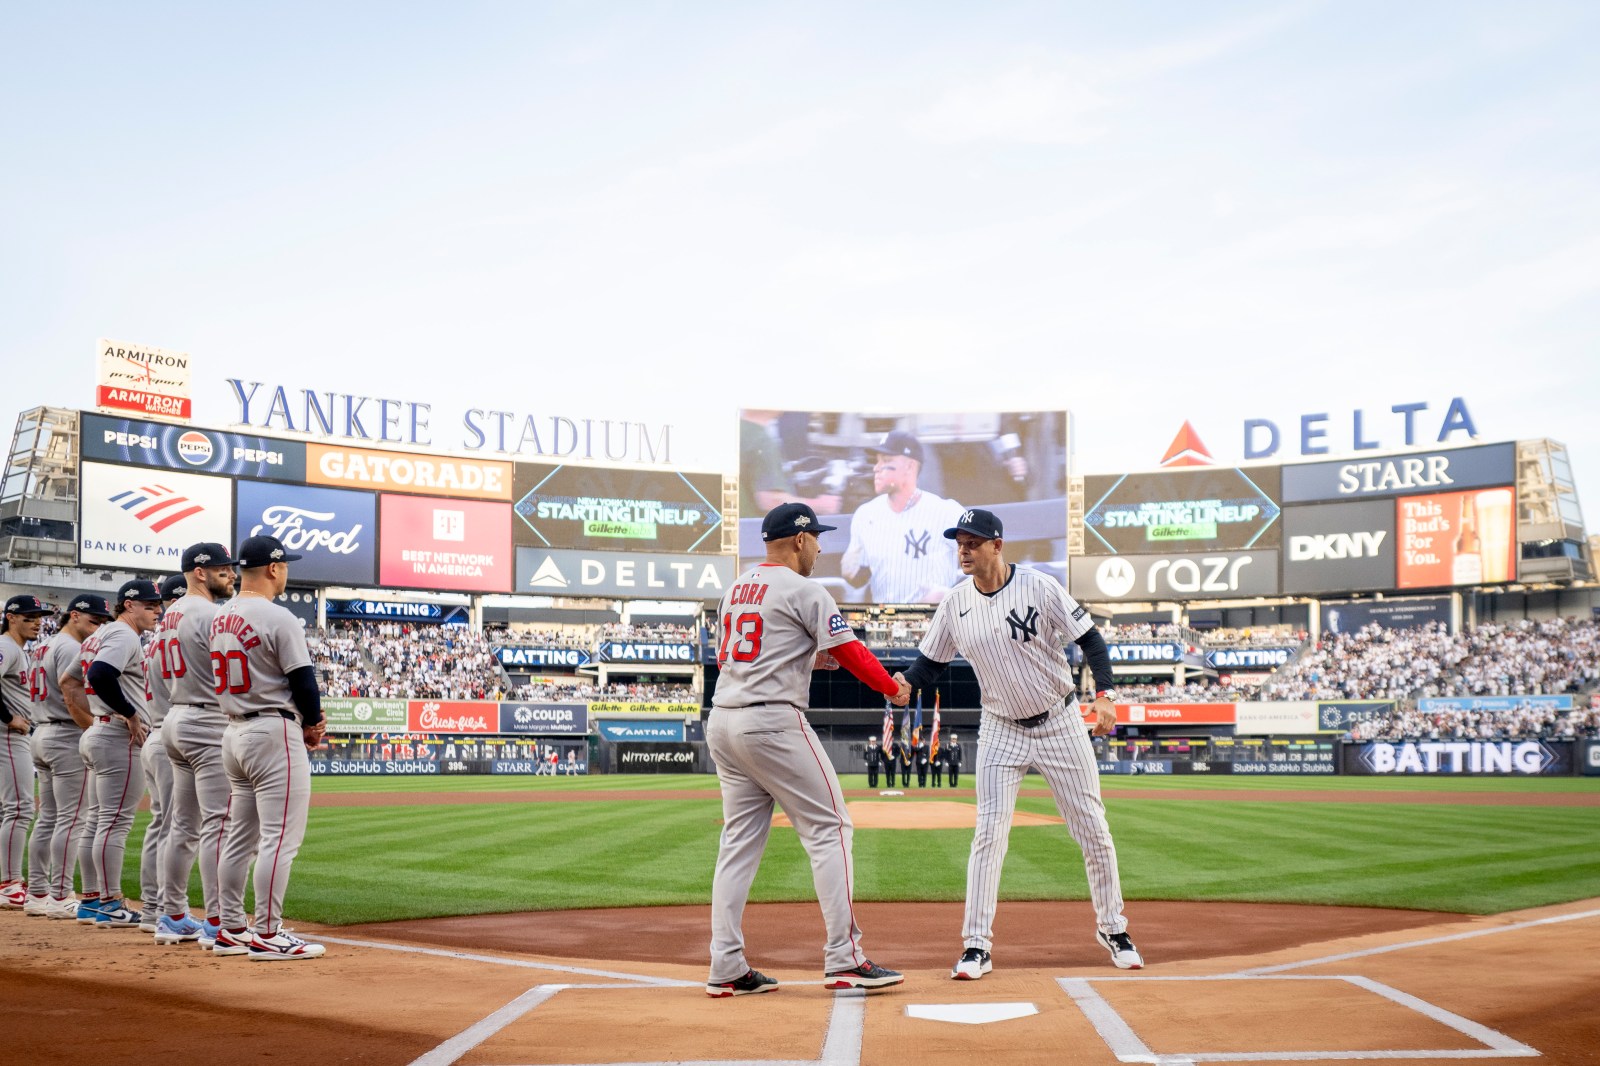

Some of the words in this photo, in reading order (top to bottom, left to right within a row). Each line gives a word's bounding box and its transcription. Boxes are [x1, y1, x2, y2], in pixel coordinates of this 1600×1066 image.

[104, 347, 187, 369] ARMITRON
[108, 389, 185, 409] ARMITRON
[145, 403, 181, 416] WATCHES
[225, 378, 432, 446] YANKEE
[463, 408, 674, 464] STADIUM
[1243, 397, 1479, 460] DELTA
[104, 430, 157, 450] PEPSI
[180, 442, 211, 453] PEPSI
[233, 447, 283, 465] PEPSI
[319, 451, 504, 492] GATORADE
[1338, 455, 1454, 494] STARR
[577, 496, 599, 505] NEW
[600, 498, 623, 507] YORK
[1404, 501, 1442, 518] This
[537, 502, 631, 522] STARTING
[633, 506, 701, 526] LINEUP
[1104, 509, 1193, 528] STARTING
[1196, 504, 1260, 523] LINEUP
[250, 505, 362, 554] Ford
[588, 523, 628, 535] Gillette
[1152, 528, 1189, 537] Gillette
[1404, 516, 1450, 533] Bud's
[84, 539, 127, 553] BANK
[132, 544, 151, 554] OF
[1289, 530, 1387, 562] DKNY
[1405, 534, 1434, 549] For
[402, 550, 431, 562] BEST
[434, 553, 494, 566] NETWORK
[1404, 550, 1441, 566] You.
[413, 563, 427, 573] IN
[429, 565, 483, 577] AMERICA
[581, 558, 723, 590] DELTA
[1147, 556, 1253, 594] razr
[730, 583, 769, 605] CORA
[365, 602, 429, 616] BATTING
[1005, 605, 1040, 642] NY
[719, 612, 763, 662] 13
[158, 638, 187, 679] 10
[502, 649, 579, 665] BATTING
[612, 644, 690, 660] BATTING
[1108, 645, 1175, 661] ATTING
[1214, 650, 1288, 666] BATTING
[210, 650, 252, 695] 30
[1232, 676, 1261, 684] TOYOTA
[532, 709, 573, 724] coupa
[591, 704, 622, 712] Gillette
[630, 705, 660, 713] Gillette
[667, 705, 698, 713] Gillette
[1147, 709, 1182, 718] TOYOTA
[622, 752, 695, 763] NITTOTIRE.COM
[1374, 741, 1542, 774] BATTING
[330, 761, 381, 774] StubHub
[385, 761, 436, 774] StubHub
[496, 762, 533, 772] STARR
[1233, 763, 1266, 773] StubHub
[1269, 763, 1300, 773] StubHub
[1302, 763, 1335, 773] StubHub
